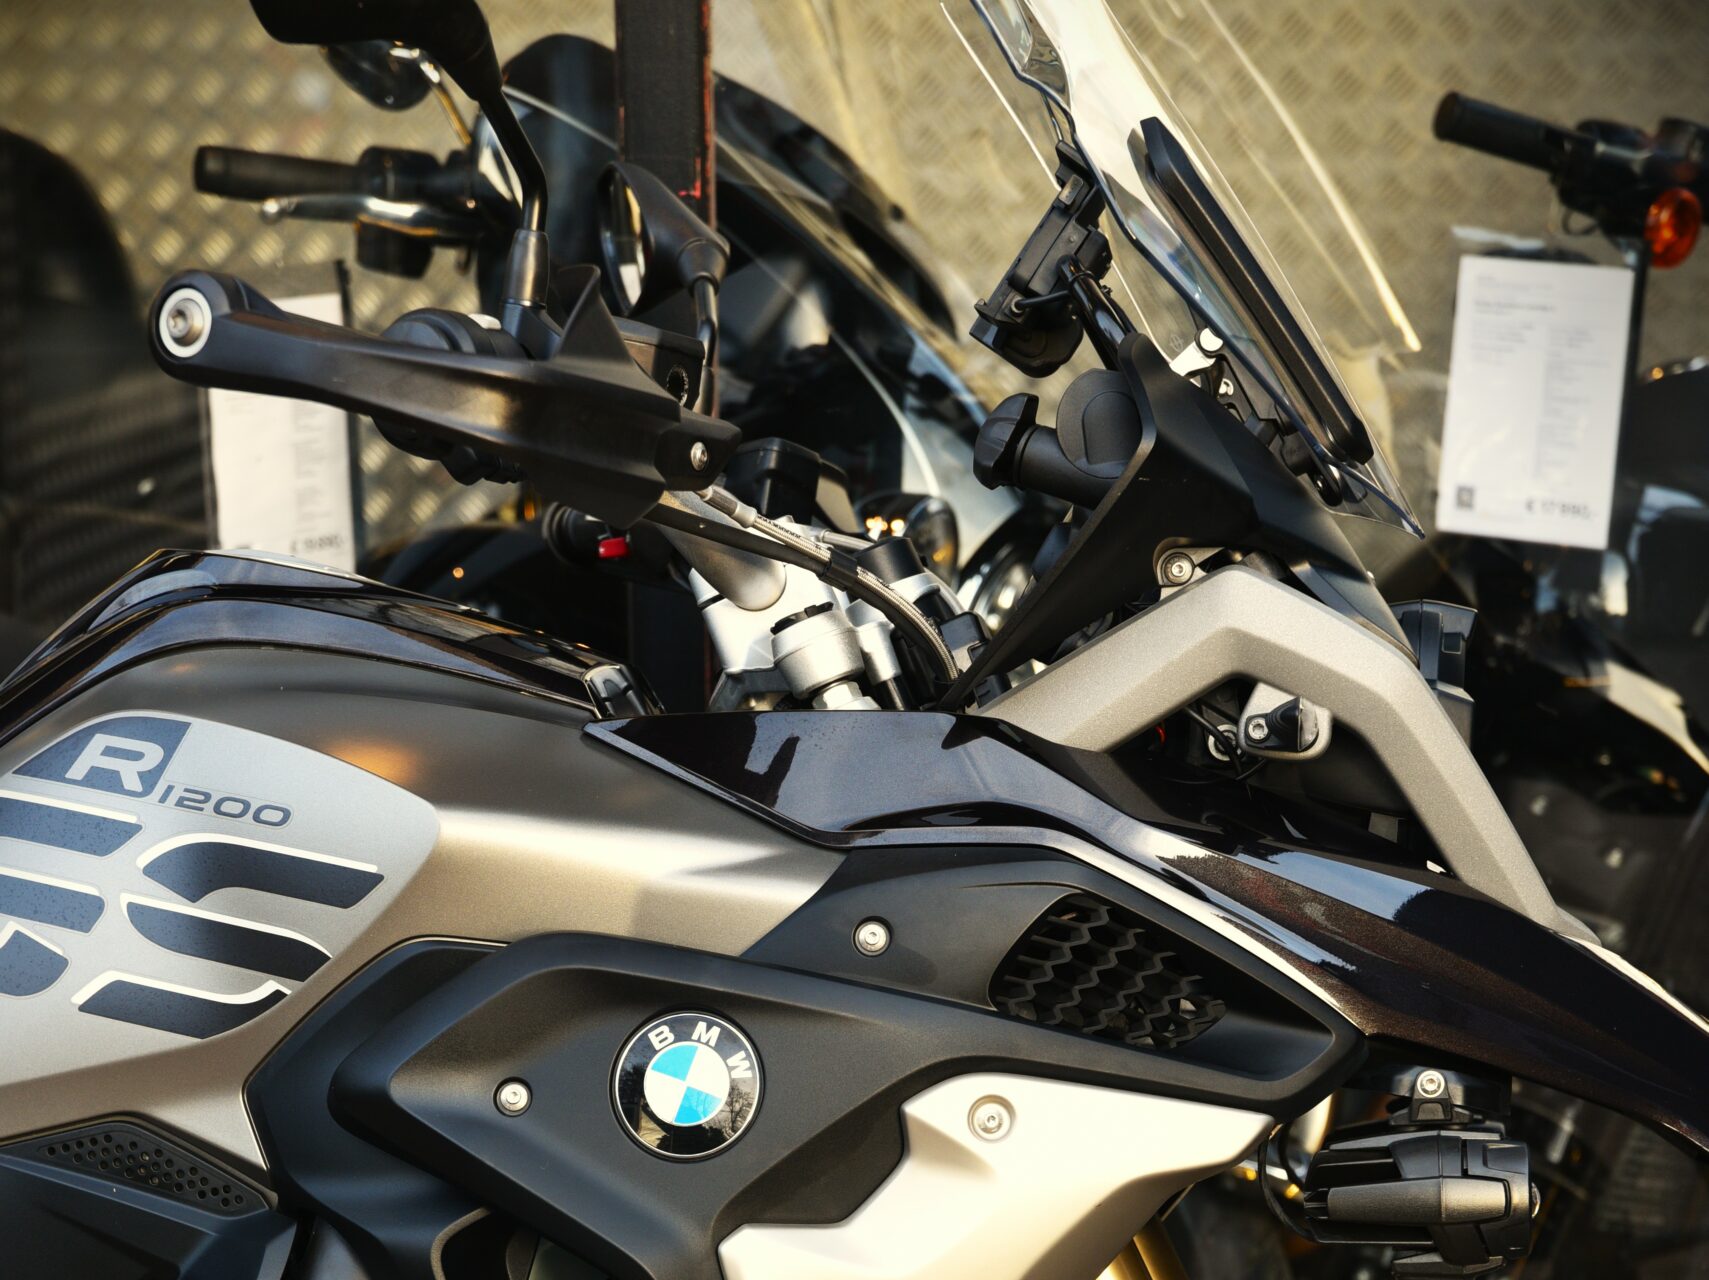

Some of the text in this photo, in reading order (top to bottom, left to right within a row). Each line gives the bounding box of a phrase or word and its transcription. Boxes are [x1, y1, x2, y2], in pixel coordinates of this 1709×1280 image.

[65, 733, 292, 827] R 1200
[647, 1021, 753, 1079] BMW
